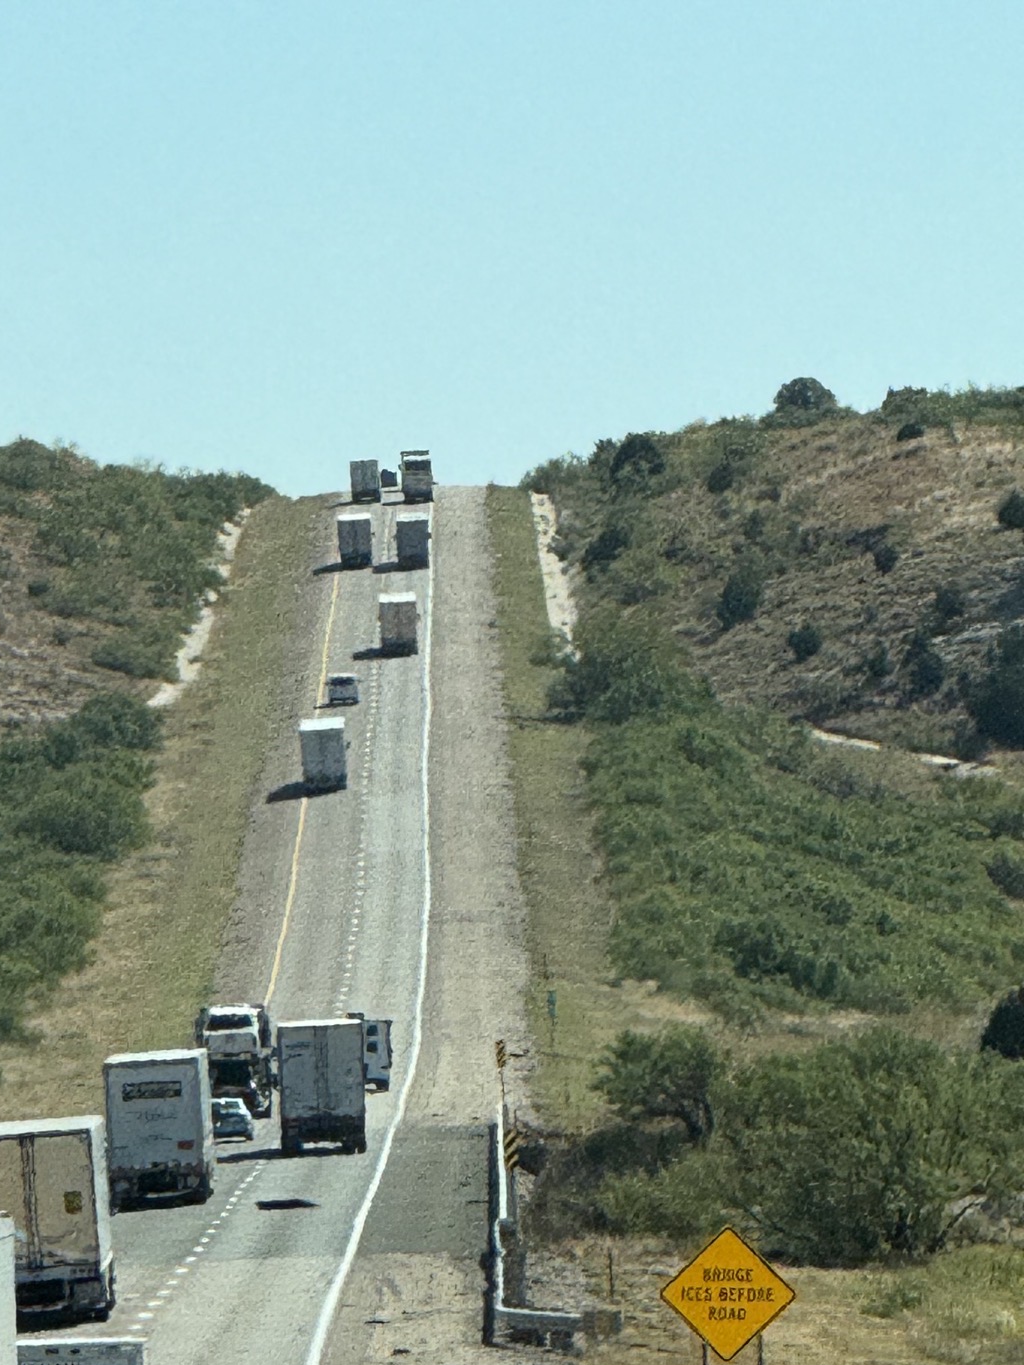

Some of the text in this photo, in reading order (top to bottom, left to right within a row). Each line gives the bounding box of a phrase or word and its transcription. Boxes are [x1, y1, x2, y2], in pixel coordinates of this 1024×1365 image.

[703, 1267, 753, 1282] BRIDGE
[681, 1286, 775, 1302] ICES BEFORE
[708, 1306, 746, 1320] ROAD
